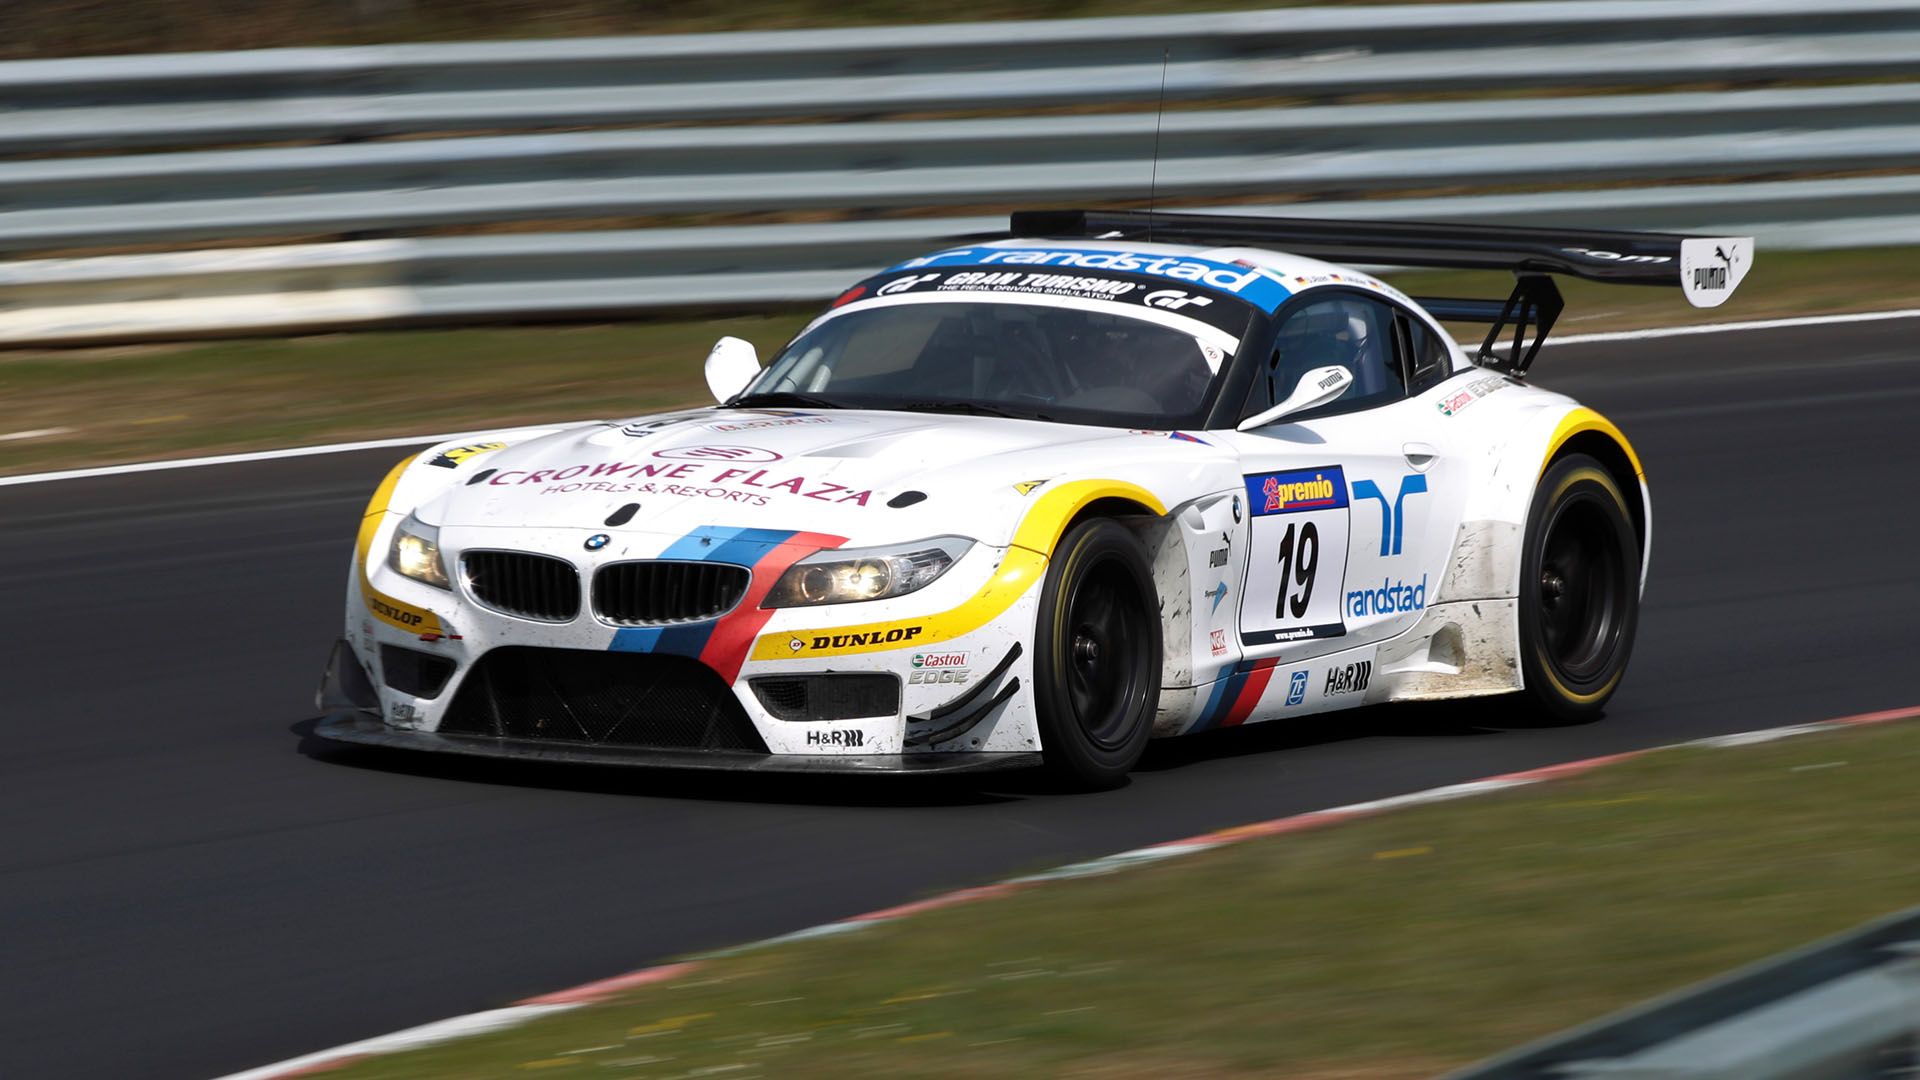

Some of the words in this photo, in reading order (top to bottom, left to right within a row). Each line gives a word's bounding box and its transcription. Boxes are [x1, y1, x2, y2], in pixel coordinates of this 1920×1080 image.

[943, 272, 1022, 286] GRAN
[1018, 273, 1136, 295] TURISMO
[978, 250, 1262, 294] randstad
[1694, 267, 1726, 290] PUMA
[936, 284, 960, 292] THE
[960, 284, 992, 293] REAL
[993, 285, 1043, 294] DRIVING
[1044, 287, 1116, 301] SIMULATOR
[1317, 371, 1344, 390] PUMA
[488, 462, 705, 486] CROWNE
[711, 468, 873, 507] PLAZA
[539, 480, 637, 495] HOTELS
[637, 481, 653, 493] &
[661, 483, 772, 506] RESORTS
[1277, 474, 1334, 509] premio
[1275, 521, 1319, 620] 19
[1346, 573, 1427, 618] randstad
[372, 598, 423, 627] DUNLOP
[810, 626, 923, 650] DUNLOP
[924, 653, 966, 668] Castrol
[907, 669, 972, 686] EDGE
[1290, 679, 1306, 698] ZF
[807, 731, 843, 745] H&R
